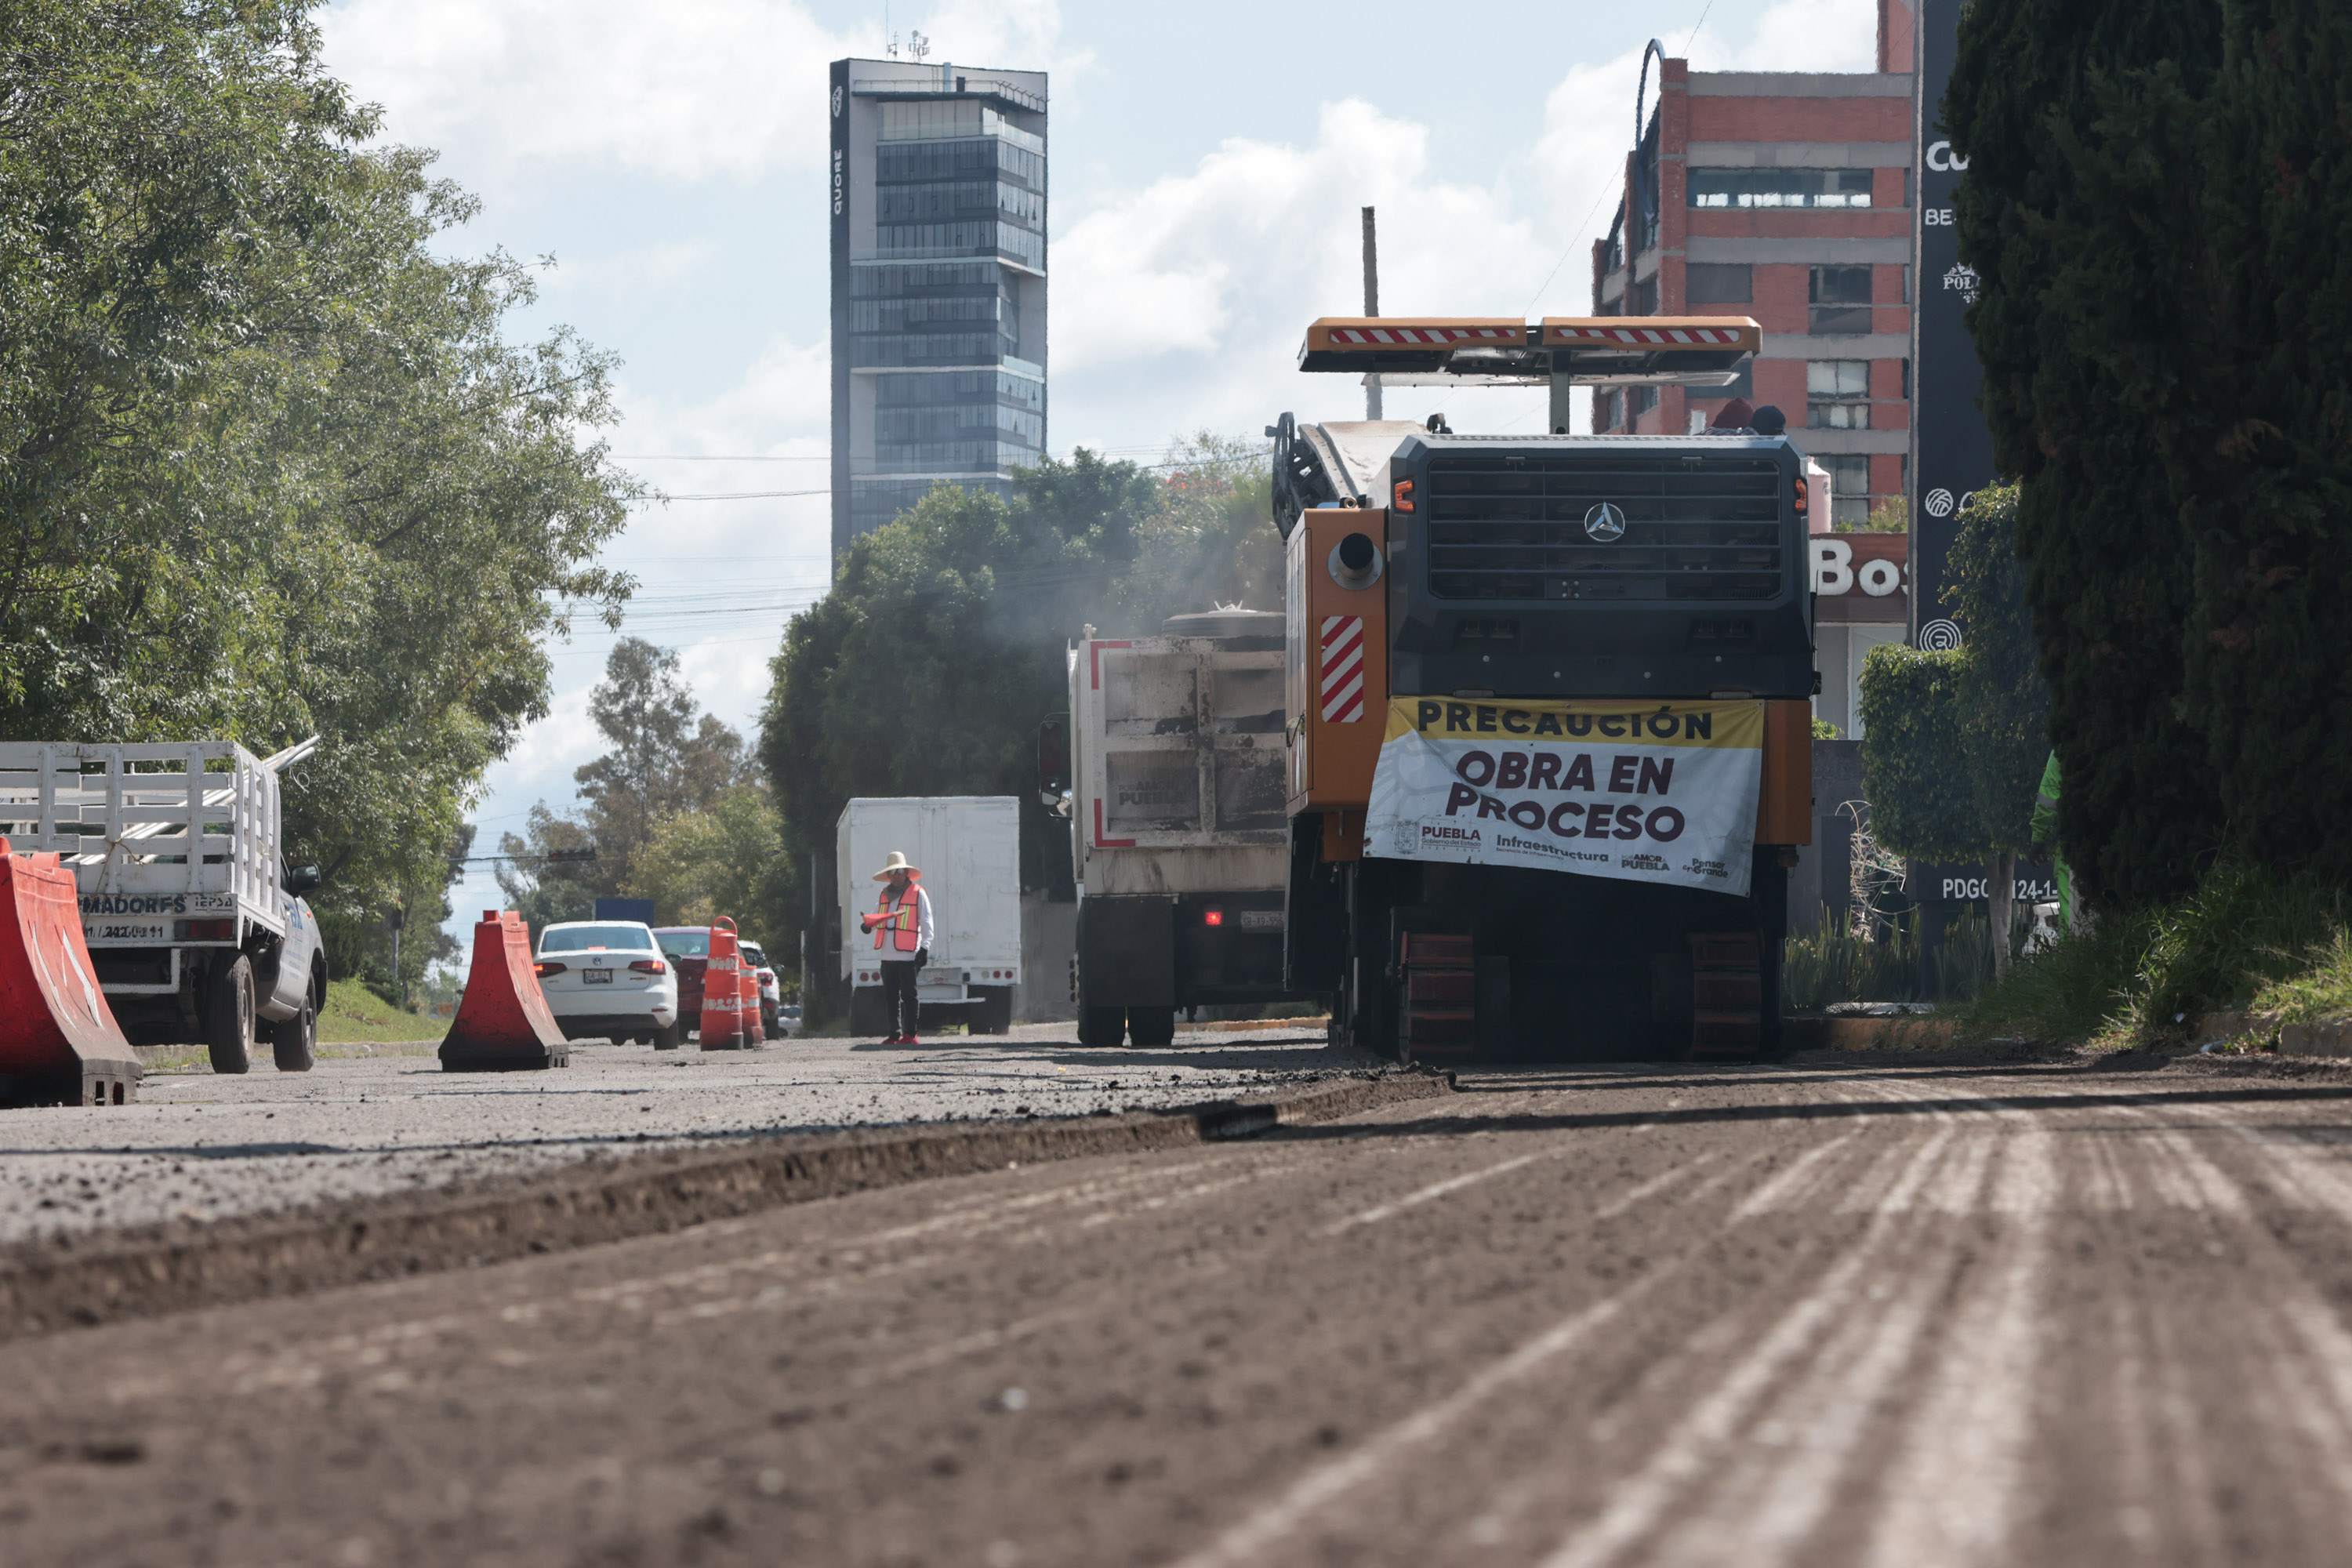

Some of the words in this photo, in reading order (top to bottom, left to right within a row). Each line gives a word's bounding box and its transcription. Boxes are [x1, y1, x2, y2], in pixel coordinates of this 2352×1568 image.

[834, 149, 843, 215] QUORE
[1925, 209, 1957, 226] BE
[1417, 700, 1711, 739] PRECAUCIÓN
[1456, 750, 1595, 792] OBRA
[1608, 755, 1675, 795] EN
[1445, 782, 1685, 842] PROCESO
[1422, 826, 1481, 840] PUEBLA
[1497, 834, 1609, 862] Infraestructura
[1621, 859, 1670, 871] PUEBLA
[1634, 854, 1663, 862] AMOR
[1692, 858, 1725, 869] Pensar
[1693, 865, 1729, 878] Grande
[78, 896, 187, 914] MADORES
